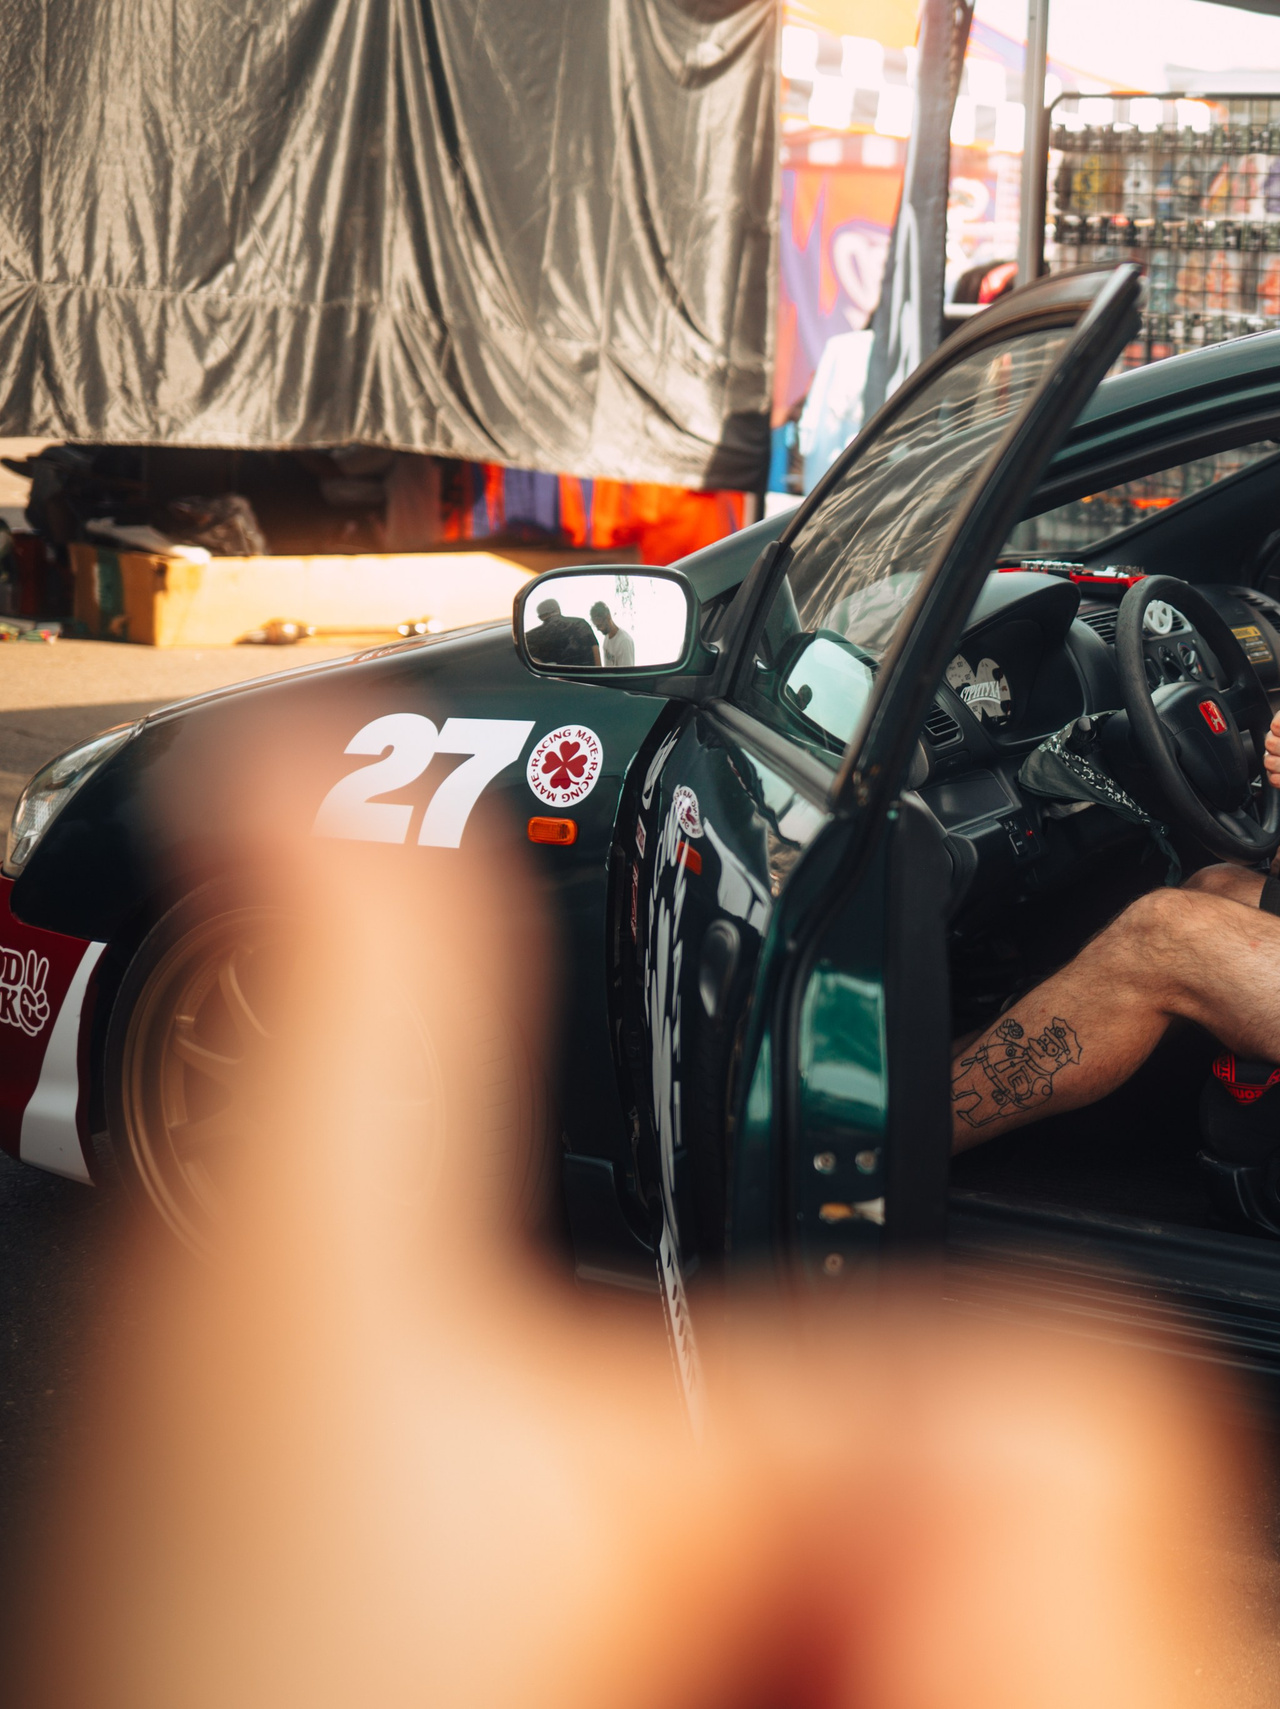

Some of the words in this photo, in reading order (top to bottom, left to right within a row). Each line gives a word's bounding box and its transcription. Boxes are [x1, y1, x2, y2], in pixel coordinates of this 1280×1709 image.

[531, 729, 571, 767] RACING
[575, 729, 599, 756] MATE
[311, 713, 536, 848] 27
[530, 773, 557, 802] MATE
[561, 761, 598, 803] RACING
